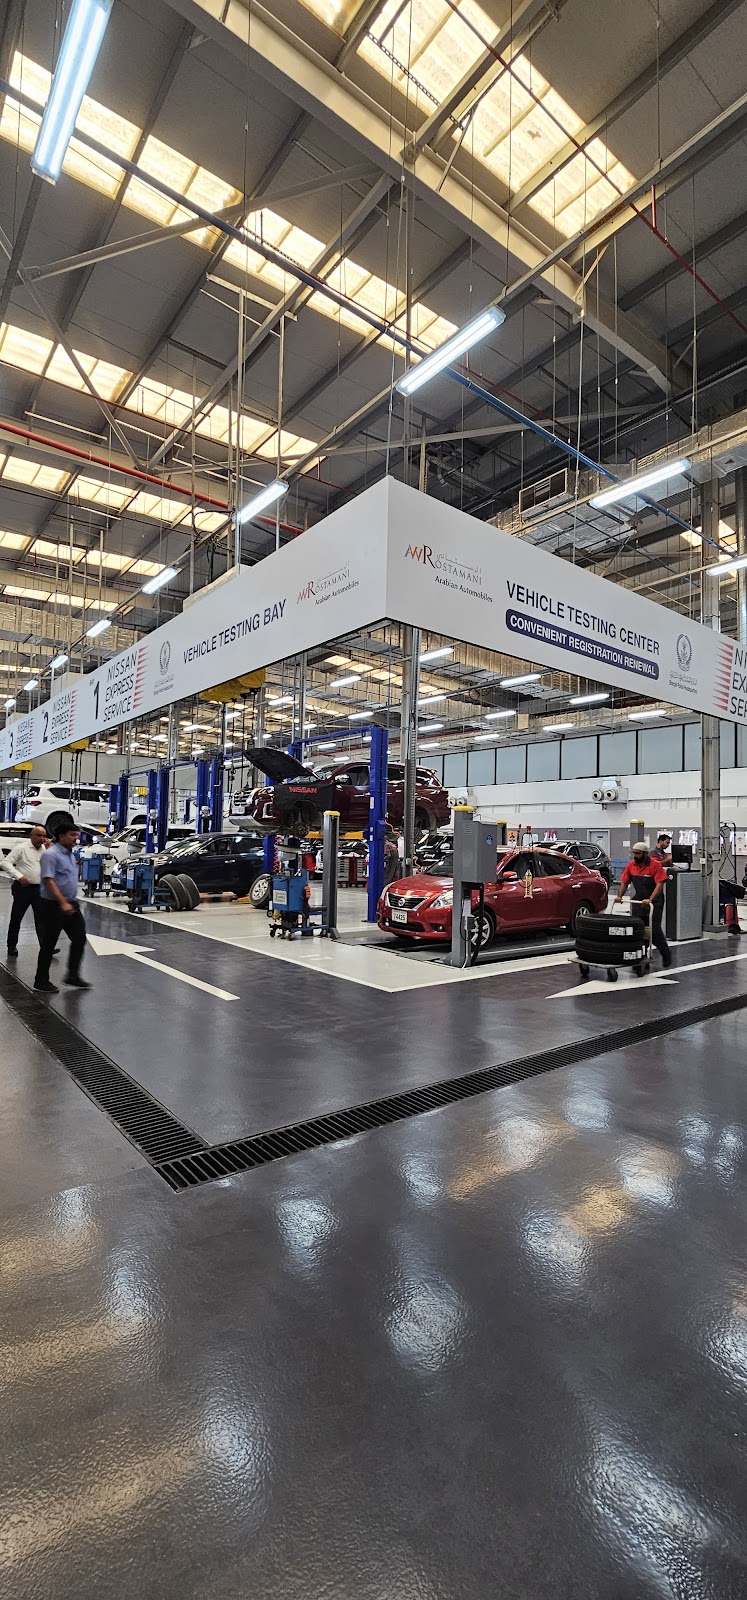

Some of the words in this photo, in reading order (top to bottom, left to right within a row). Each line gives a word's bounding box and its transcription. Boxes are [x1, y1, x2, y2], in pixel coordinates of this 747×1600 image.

[434, 575, 459, 590] Arabian
[459, 585, 493, 603] Automobiles
[183, 635, 217, 664] VEHICLE
[218, 613, 260, 647] TESTING
[263, 598, 287, 626] BAY
[506, 580, 565, 619] VEHICLE
[567, 605, 617, 639] TESTING
[619, 627, 660, 656] CENTER
[510, 614, 568, 645] CONVENIENT
[568, 635, 623, 665] REGISTRATION
[624, 655, 657, 676] RENEWAL
[107, 650, 138, 683] NISSAN
[93, 680, 100, 720] 1
[105, 673, 135, 703] EXPRESS
[103, 695, 132, 722] SERVICE
[42, 711, 49, 744] 2
[9, 732, 14, 759] 3
[289, 786, 318, 794] NISSAN
